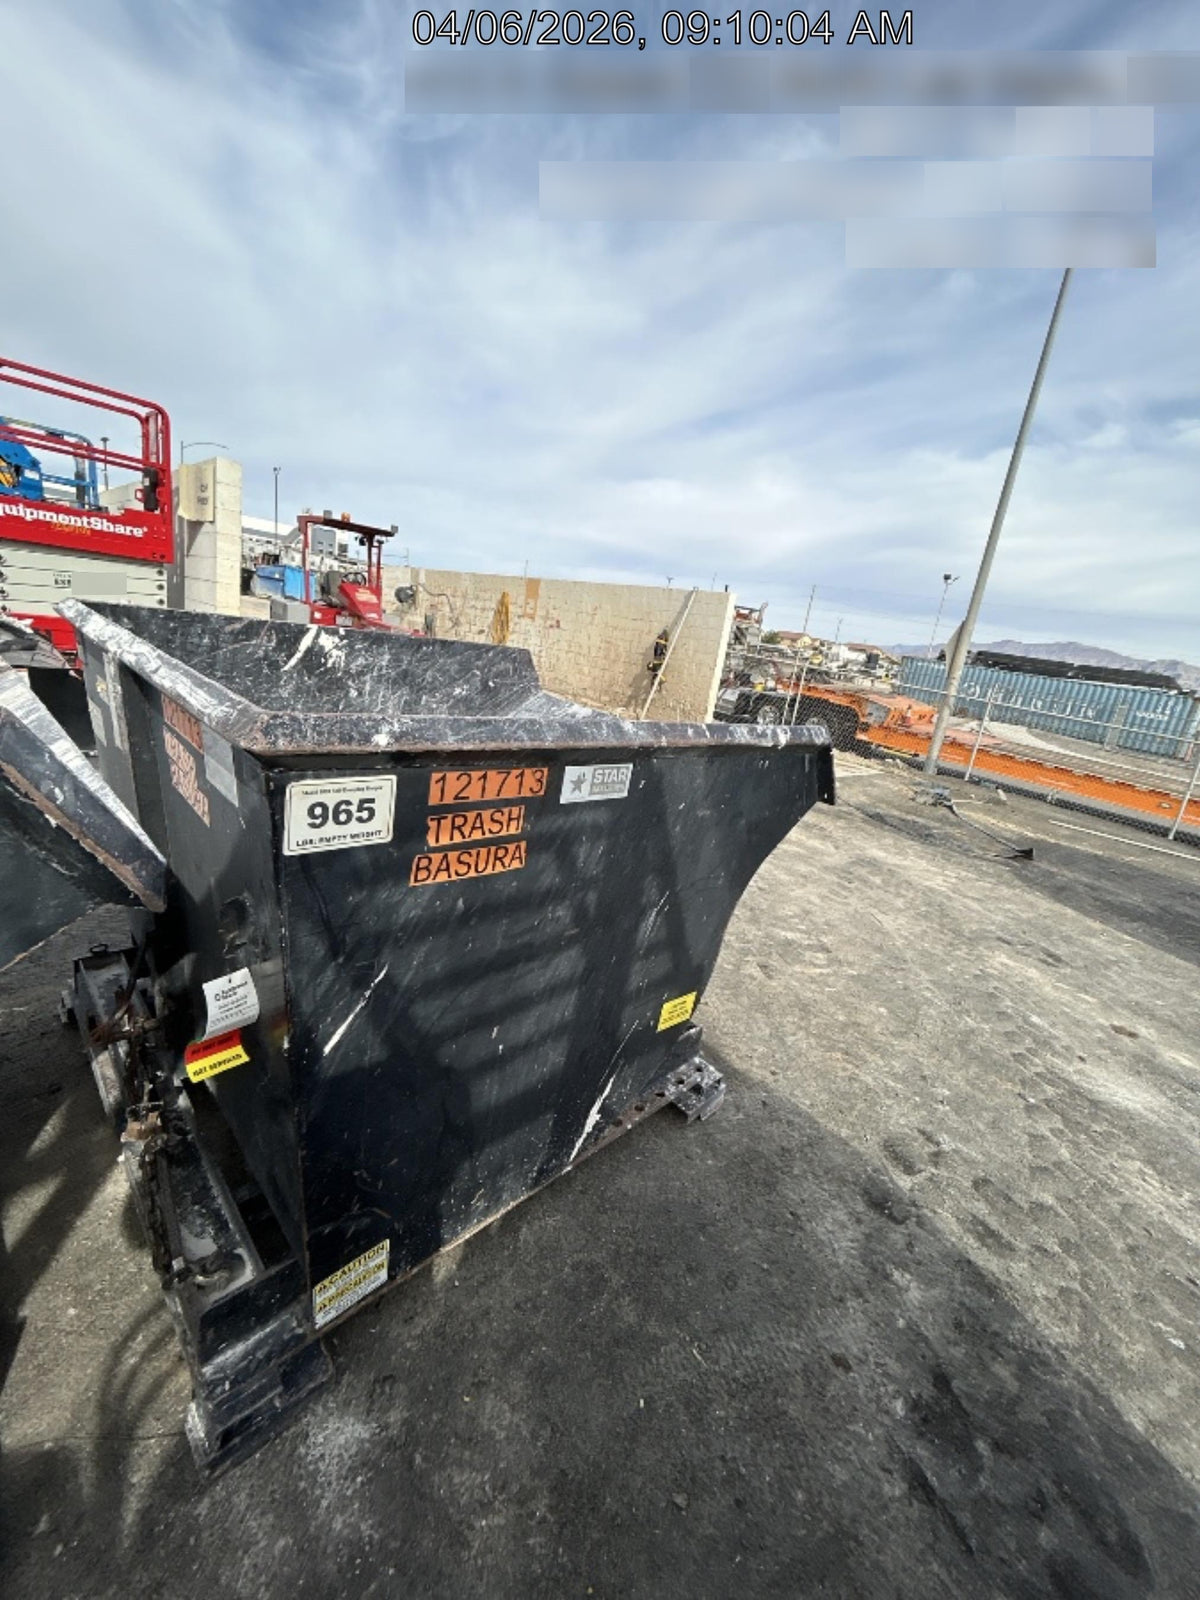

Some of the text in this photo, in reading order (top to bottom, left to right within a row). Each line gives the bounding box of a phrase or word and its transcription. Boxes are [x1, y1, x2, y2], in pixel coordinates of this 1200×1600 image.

[434, 768, 545, 803] 121713
[592, 767, 628, 784] STAR
[306, 797, 377, 830] 965
[430, 806, 523, 845] TRASH
[318, 834, 349, 844] EMPTY
[349, 829, 383, 840] WEIGHT
[413, 843, 525, 884] BASURA
[328, 1243, 385, 1285] CAUTION
